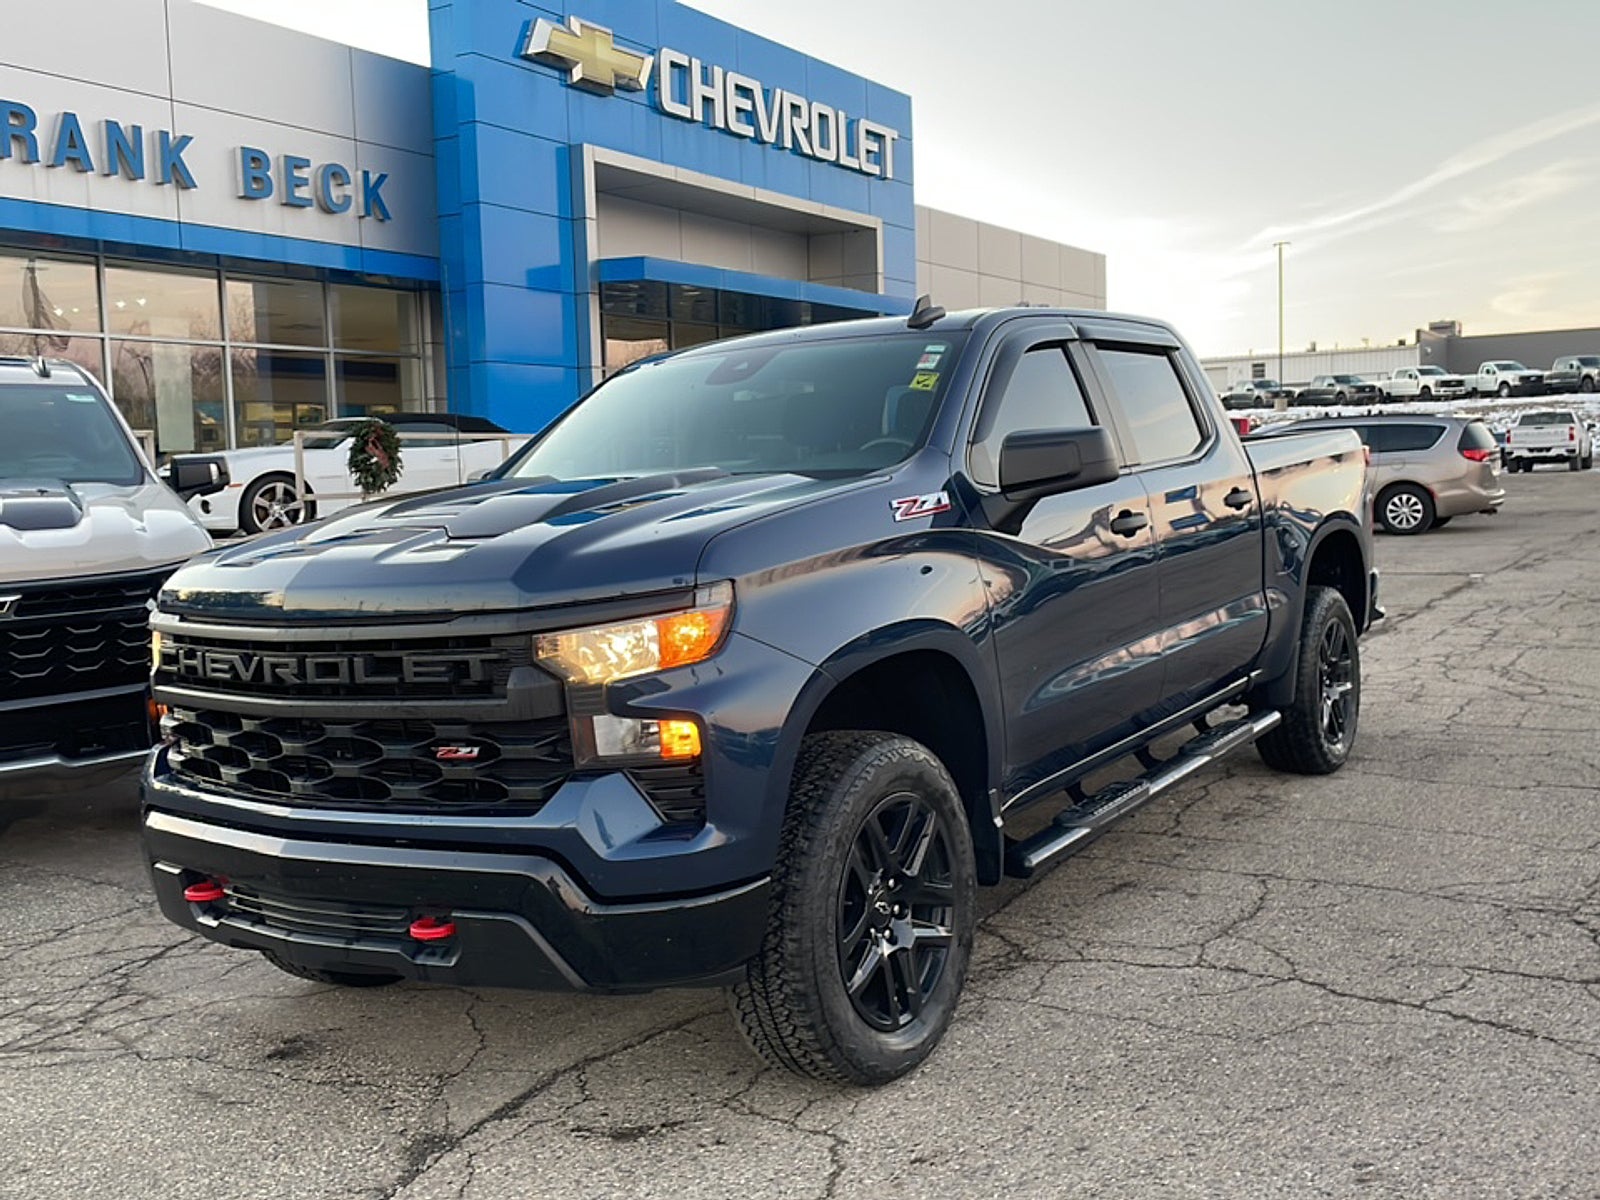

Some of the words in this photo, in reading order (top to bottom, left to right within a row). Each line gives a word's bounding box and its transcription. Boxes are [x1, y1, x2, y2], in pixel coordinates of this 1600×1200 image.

[658, 46, 898, 180] CHEVROLET
[0, 99, 198, 190] RANK
[236, 146, 392, 222] BECK
[890, 490, 951, 522] Z71
[158, 645, 499, 686] CHEVROLET
[431, 746, 480, 760] Z71
